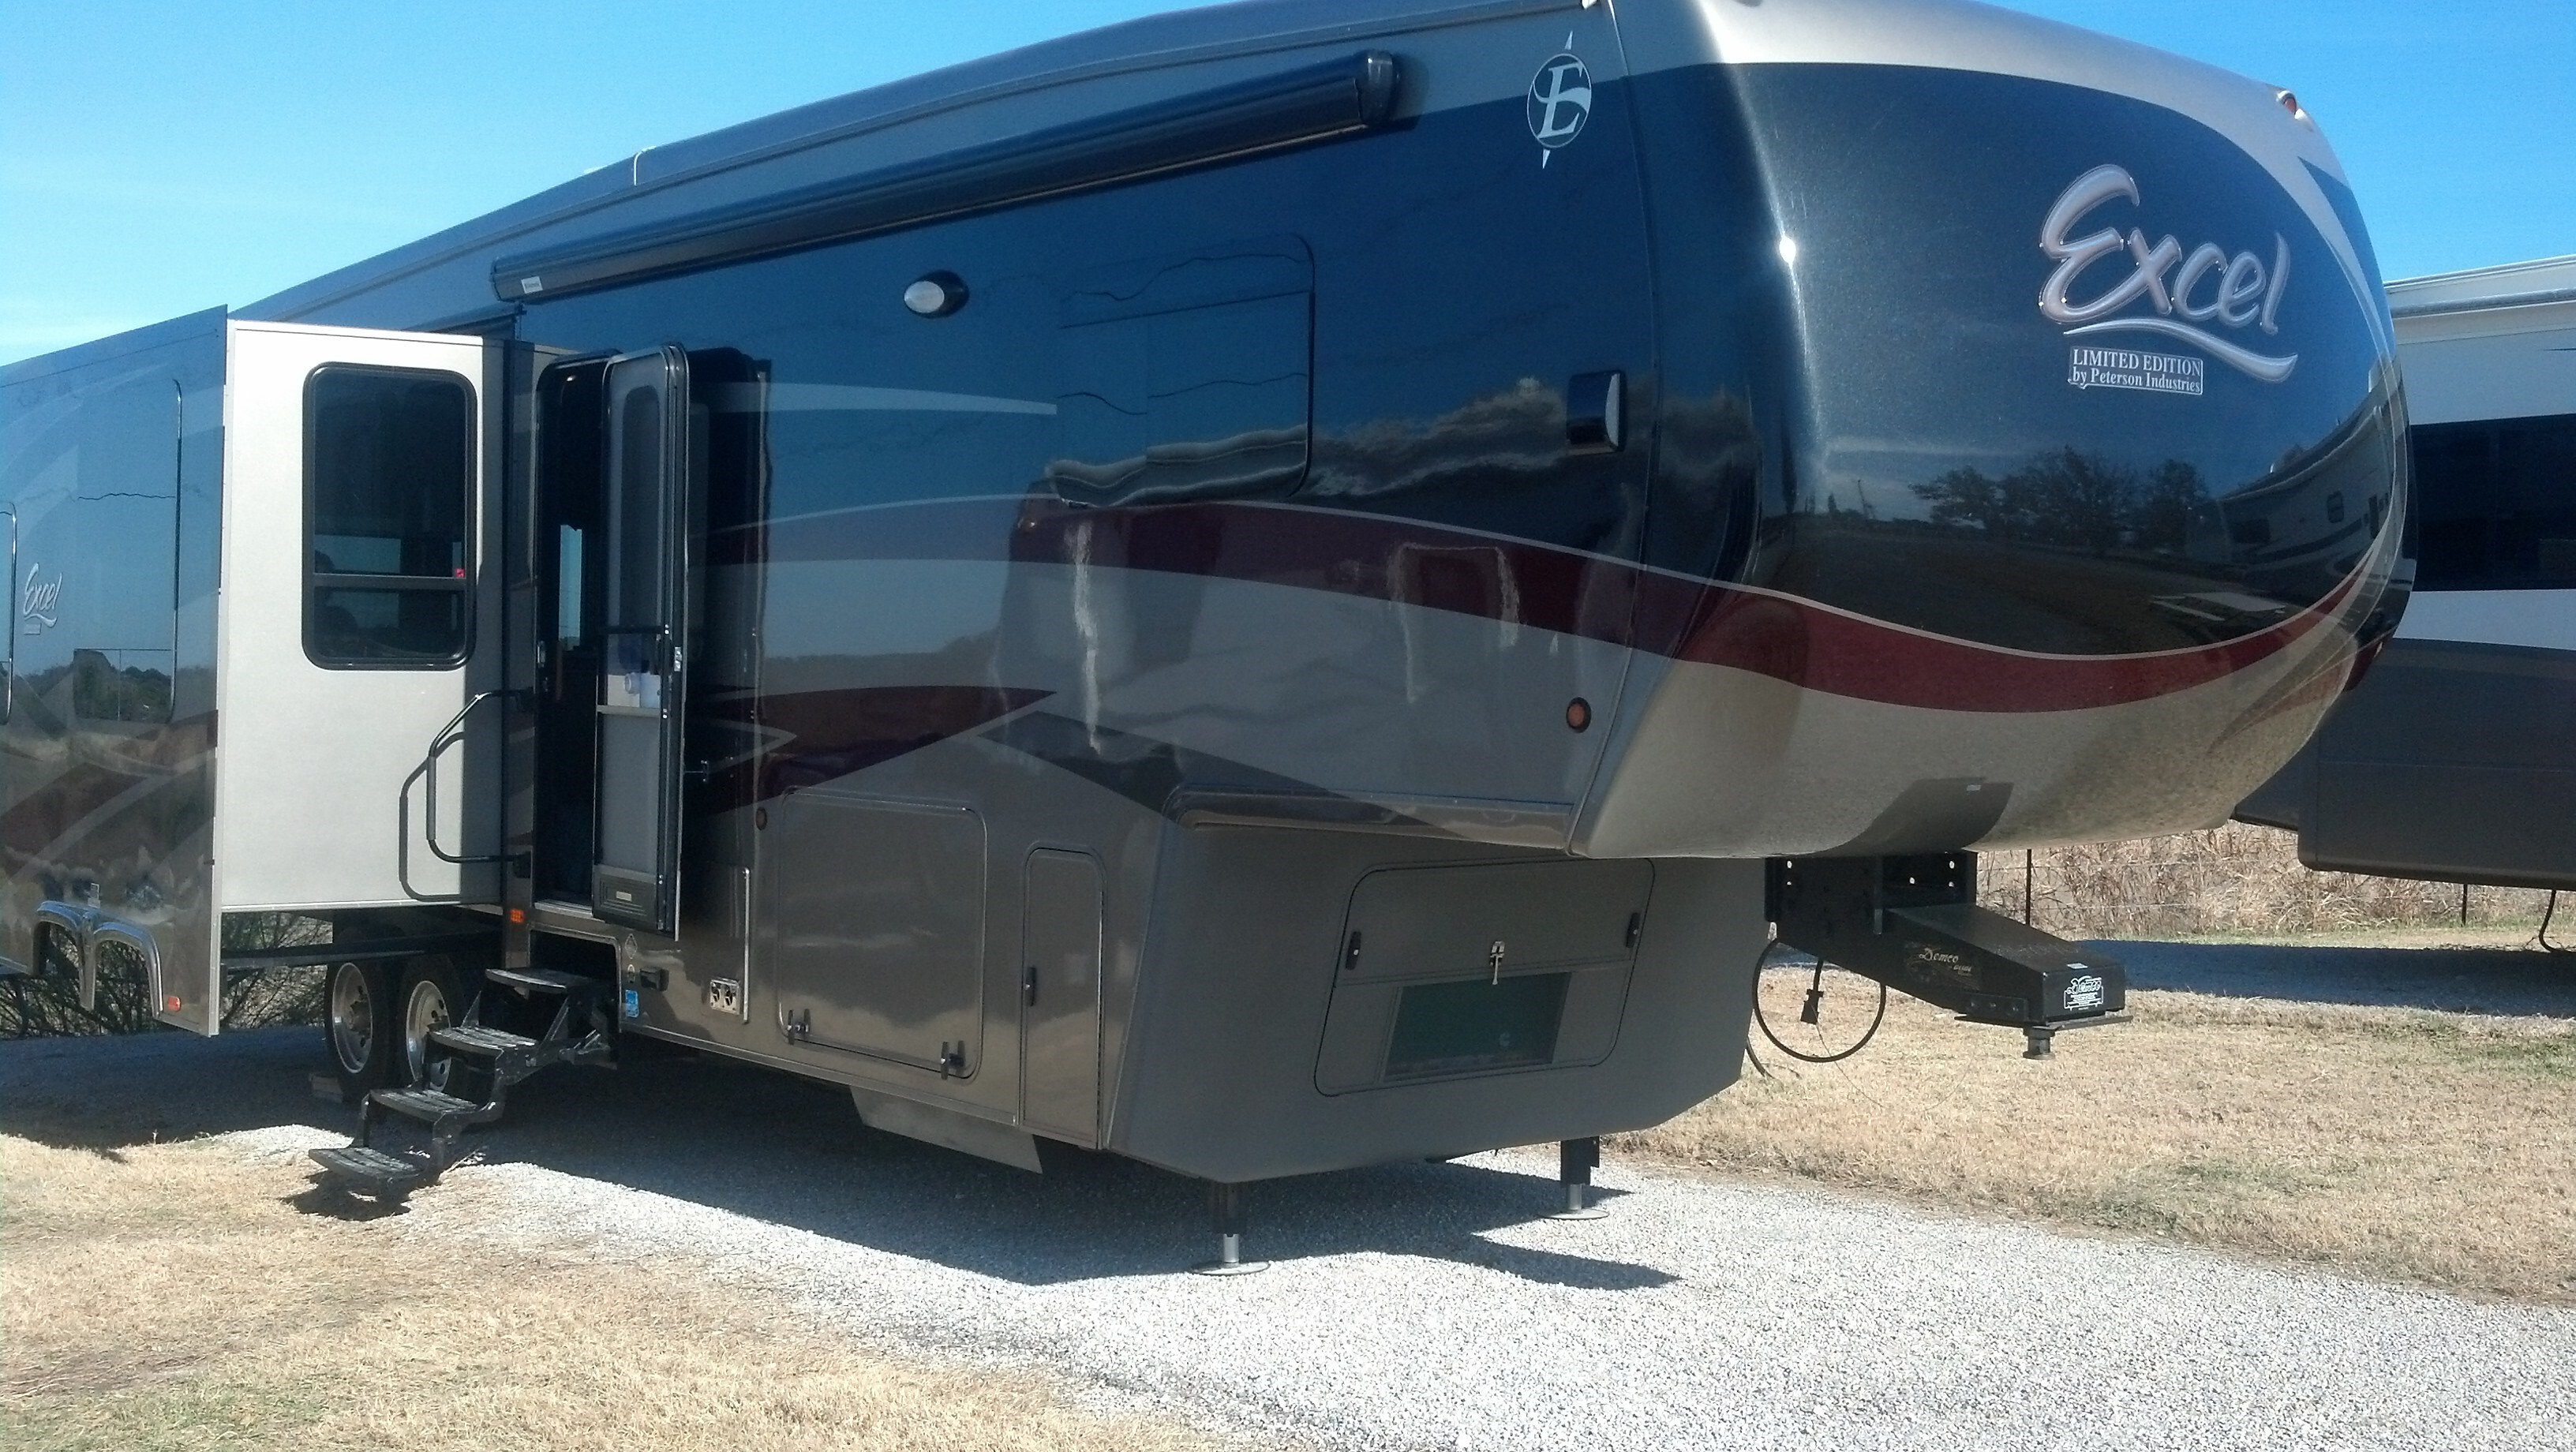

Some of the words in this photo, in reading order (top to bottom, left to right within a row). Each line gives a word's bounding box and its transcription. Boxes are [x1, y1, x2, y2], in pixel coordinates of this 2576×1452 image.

[2039, 163, 2291, 335] Excel
[2072, 349, 2140, 369] LIMITED
[2143, 354, 2201, 376] EDITION
[2072, 365, 2087, 386] by
[2090, 367, 2143, 387] Peterson
[2146, 372, 2201, 393] Industries
[23, 561, 63, 616] Excel
